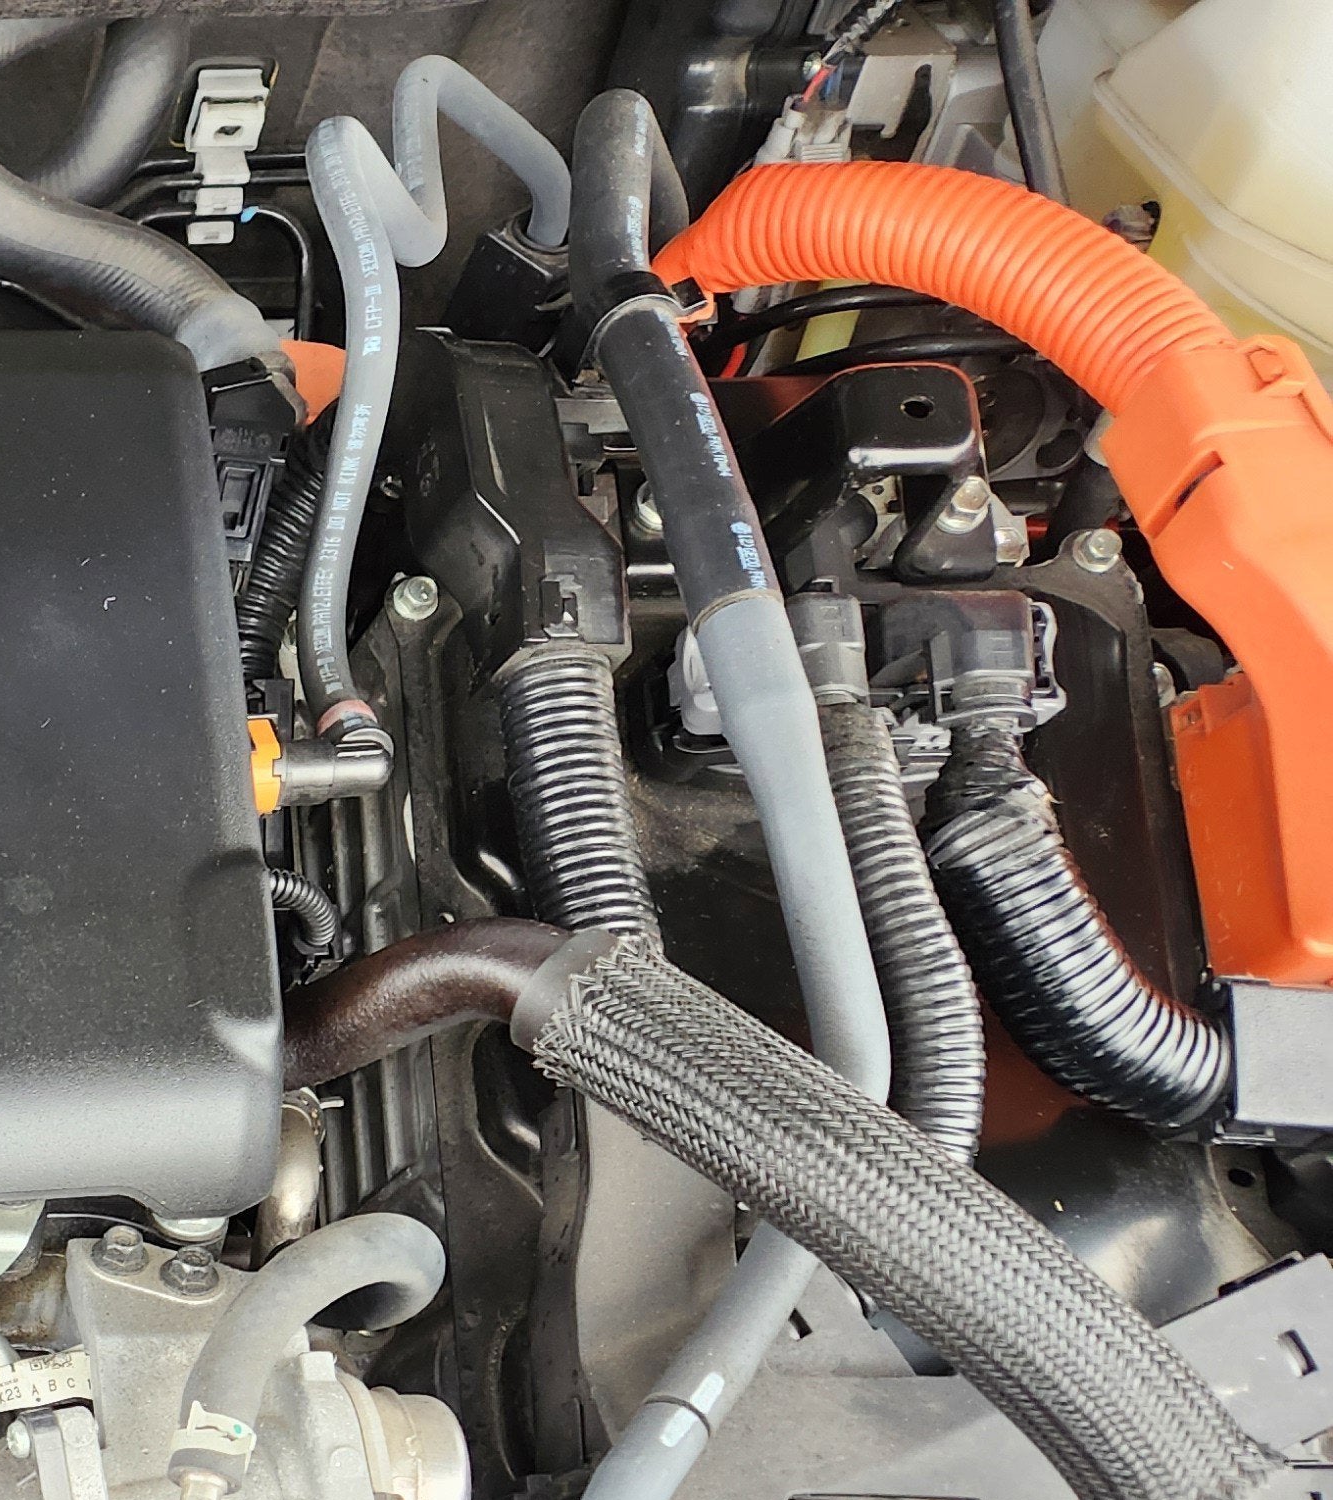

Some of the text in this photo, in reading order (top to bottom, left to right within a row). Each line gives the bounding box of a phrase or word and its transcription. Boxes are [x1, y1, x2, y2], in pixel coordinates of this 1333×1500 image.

[337, 456, 361, 485] KINK
[331, 490, 353, 511] NOT
[48, 1379, 58, 1392] B
[66, 1377, 76, 1389] C
